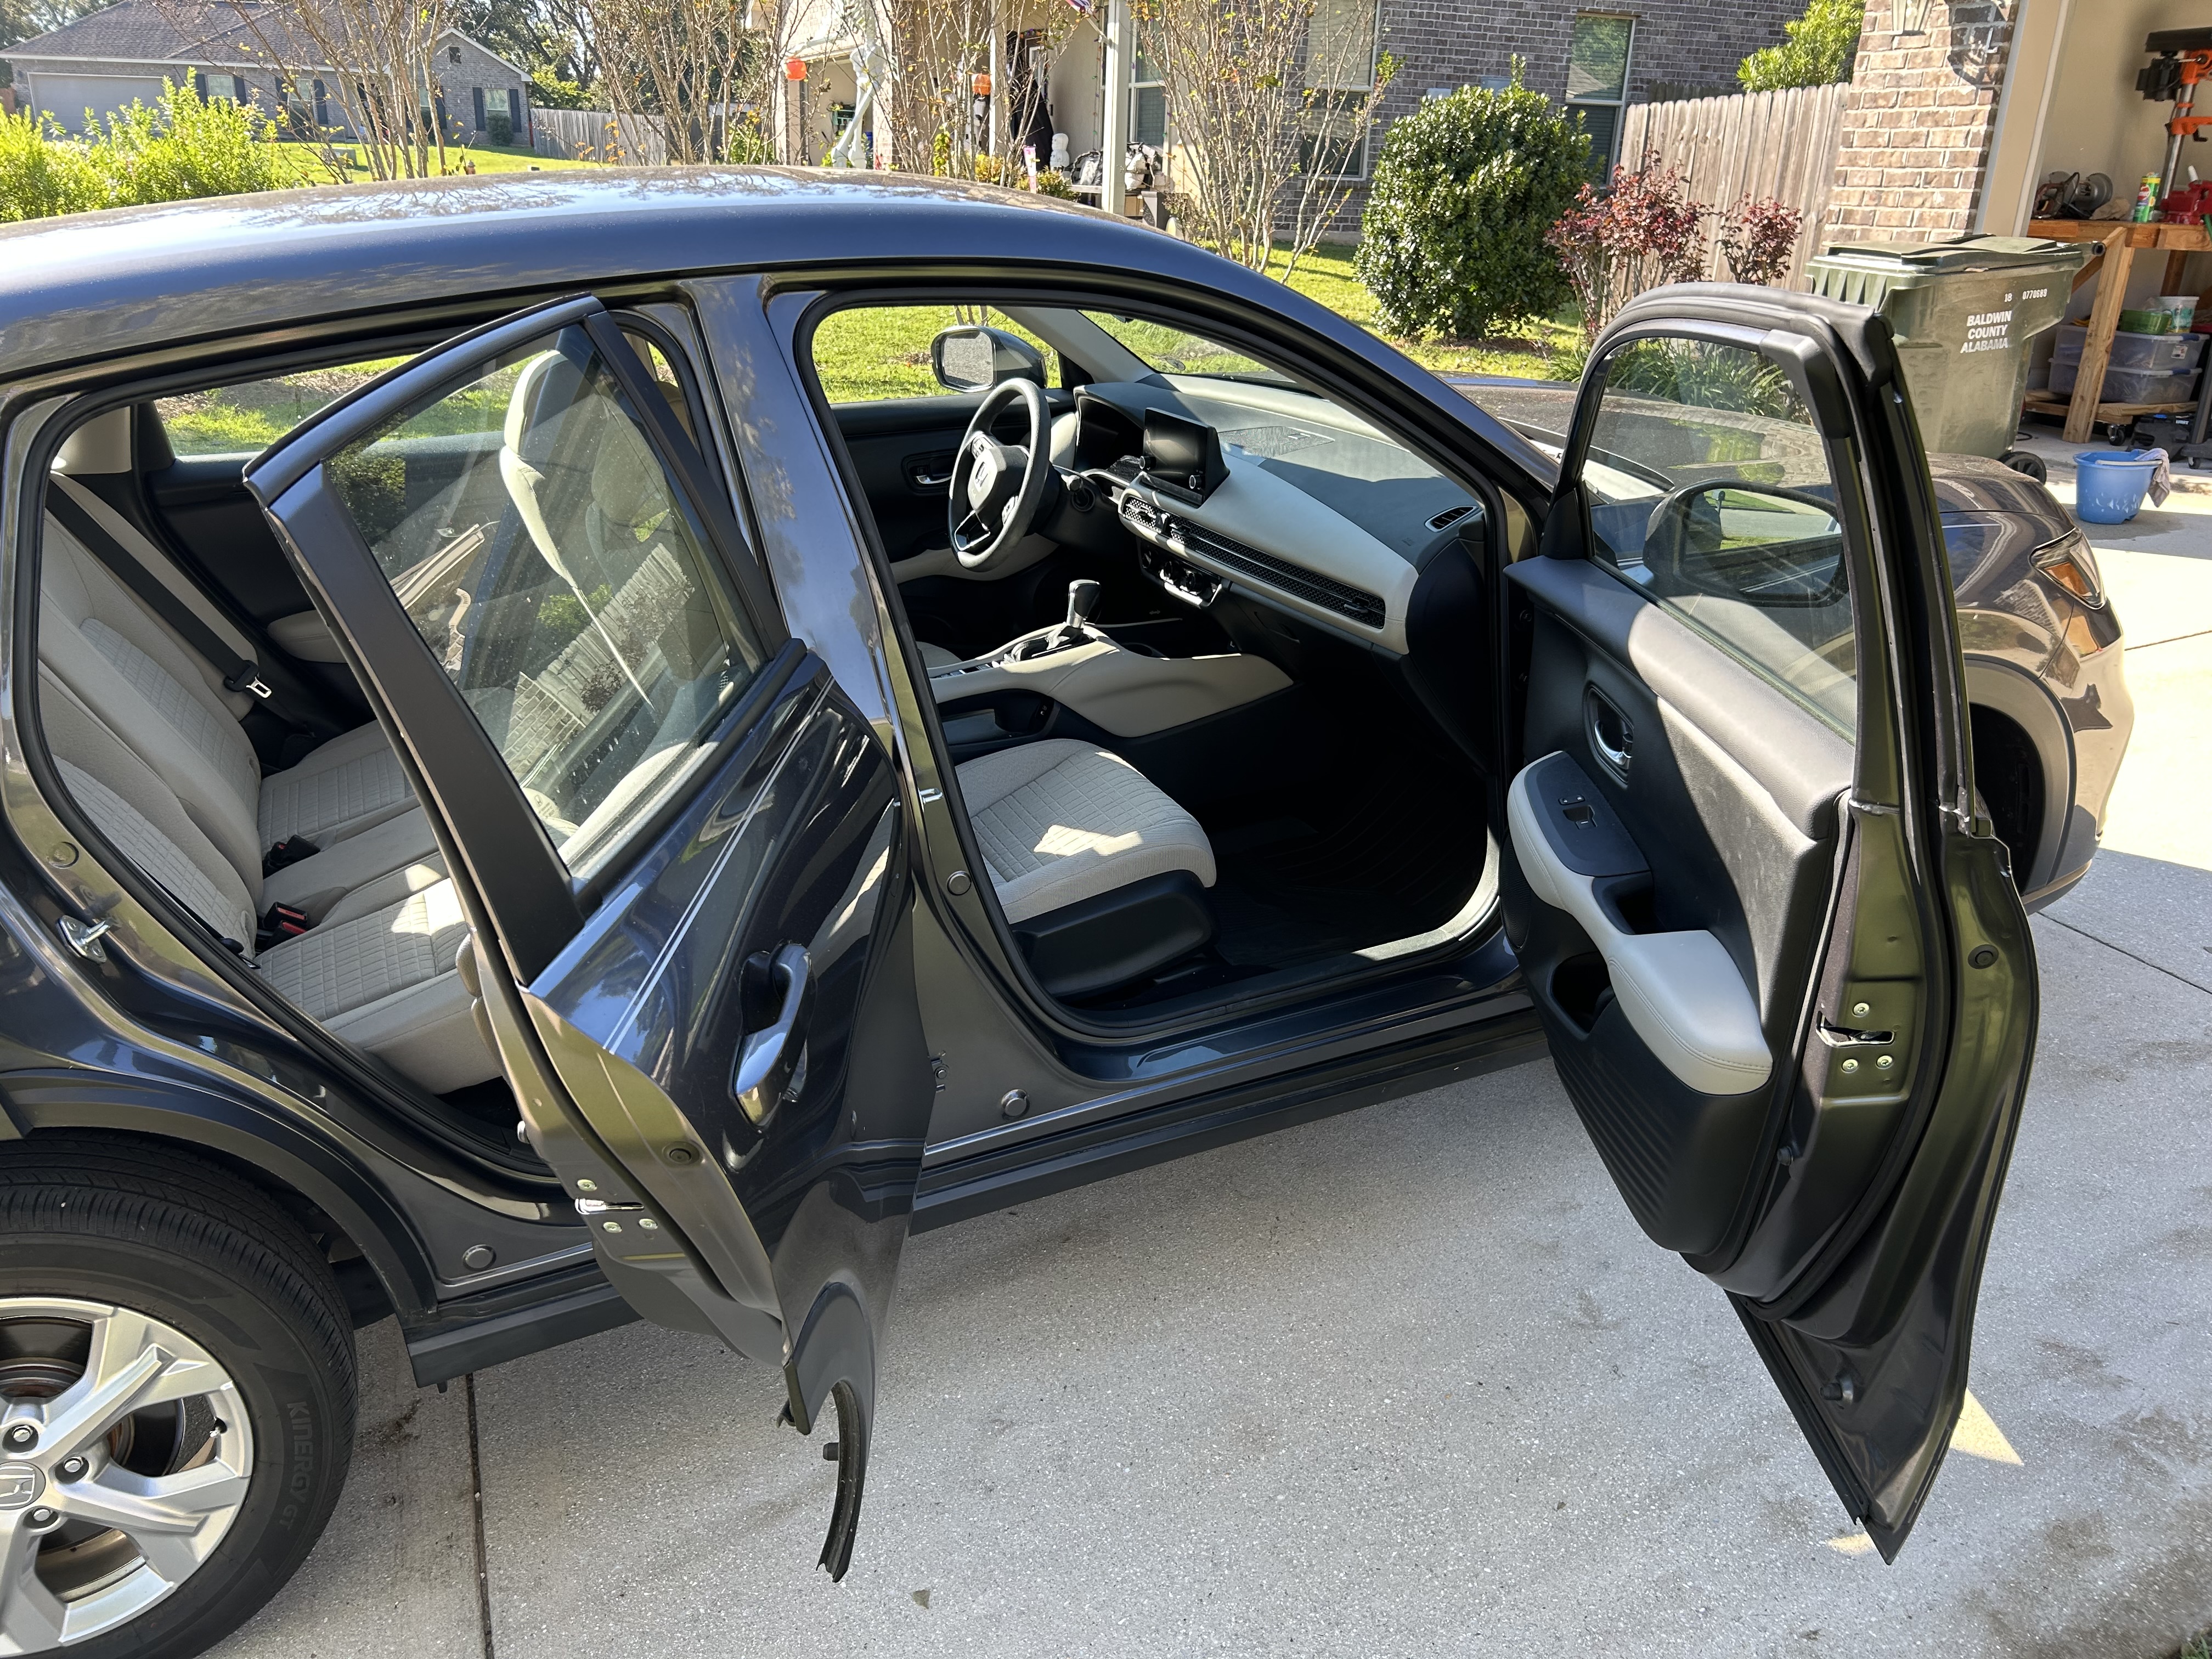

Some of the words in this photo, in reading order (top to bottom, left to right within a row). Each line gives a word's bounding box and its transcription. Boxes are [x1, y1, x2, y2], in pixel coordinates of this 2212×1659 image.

[2004, 292, 2013, 302] 18
[1966, 310, 2012, 326] BALDWIN
[1967, 324, 2008, 340] COUNTY
[1960, 337, 2008, 354] ALABAMA
[286, 1401, 313, 1503] KINERGY
[279, 1504, 298, 1531] GT
